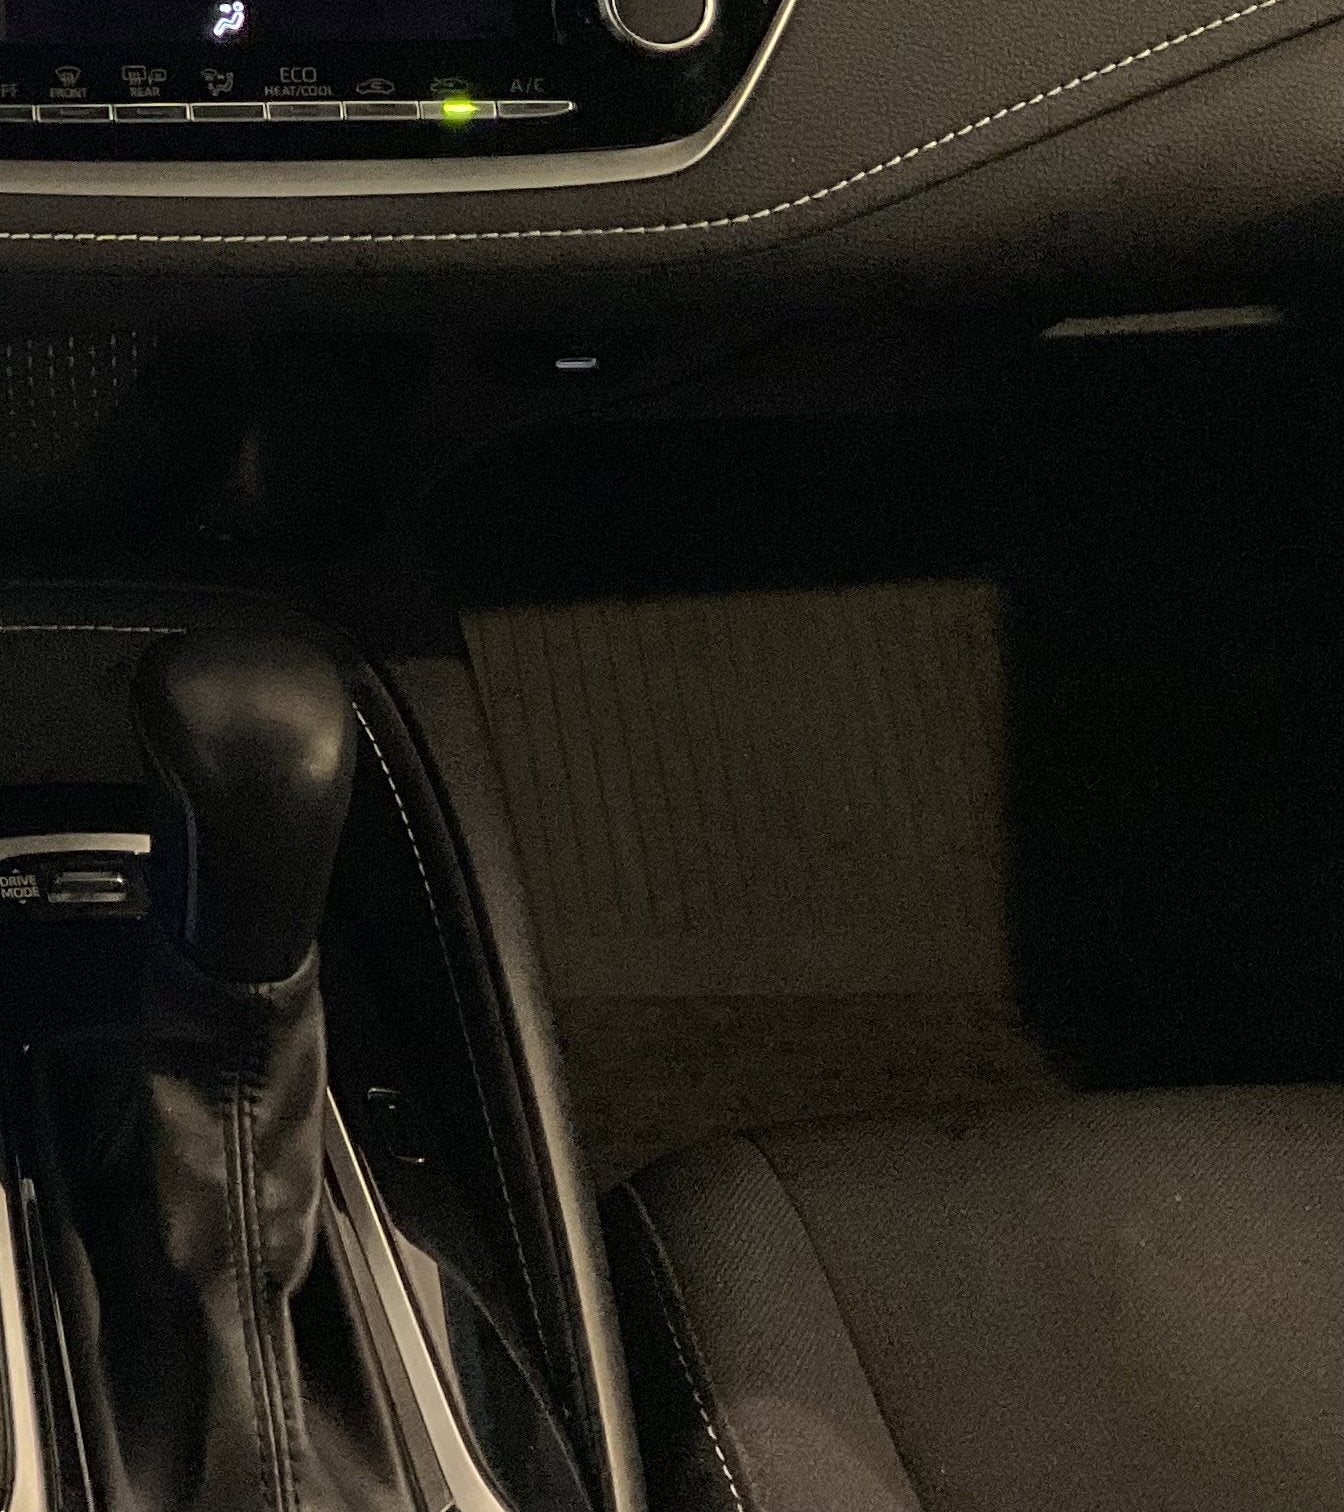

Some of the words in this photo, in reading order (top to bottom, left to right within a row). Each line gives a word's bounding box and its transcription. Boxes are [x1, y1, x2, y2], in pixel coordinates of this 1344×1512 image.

[279, 67, 317, 83] ECO
[509, 77, 545, 93] A/C
[49, 87, 87, 98] FRONT
[129, 86, 161, 97] REAR
[264, 86, 333, 97] HEAT/COOL
[0, 874, 38, 887] DRIVE
[1, 887, 41, 899] MODE
